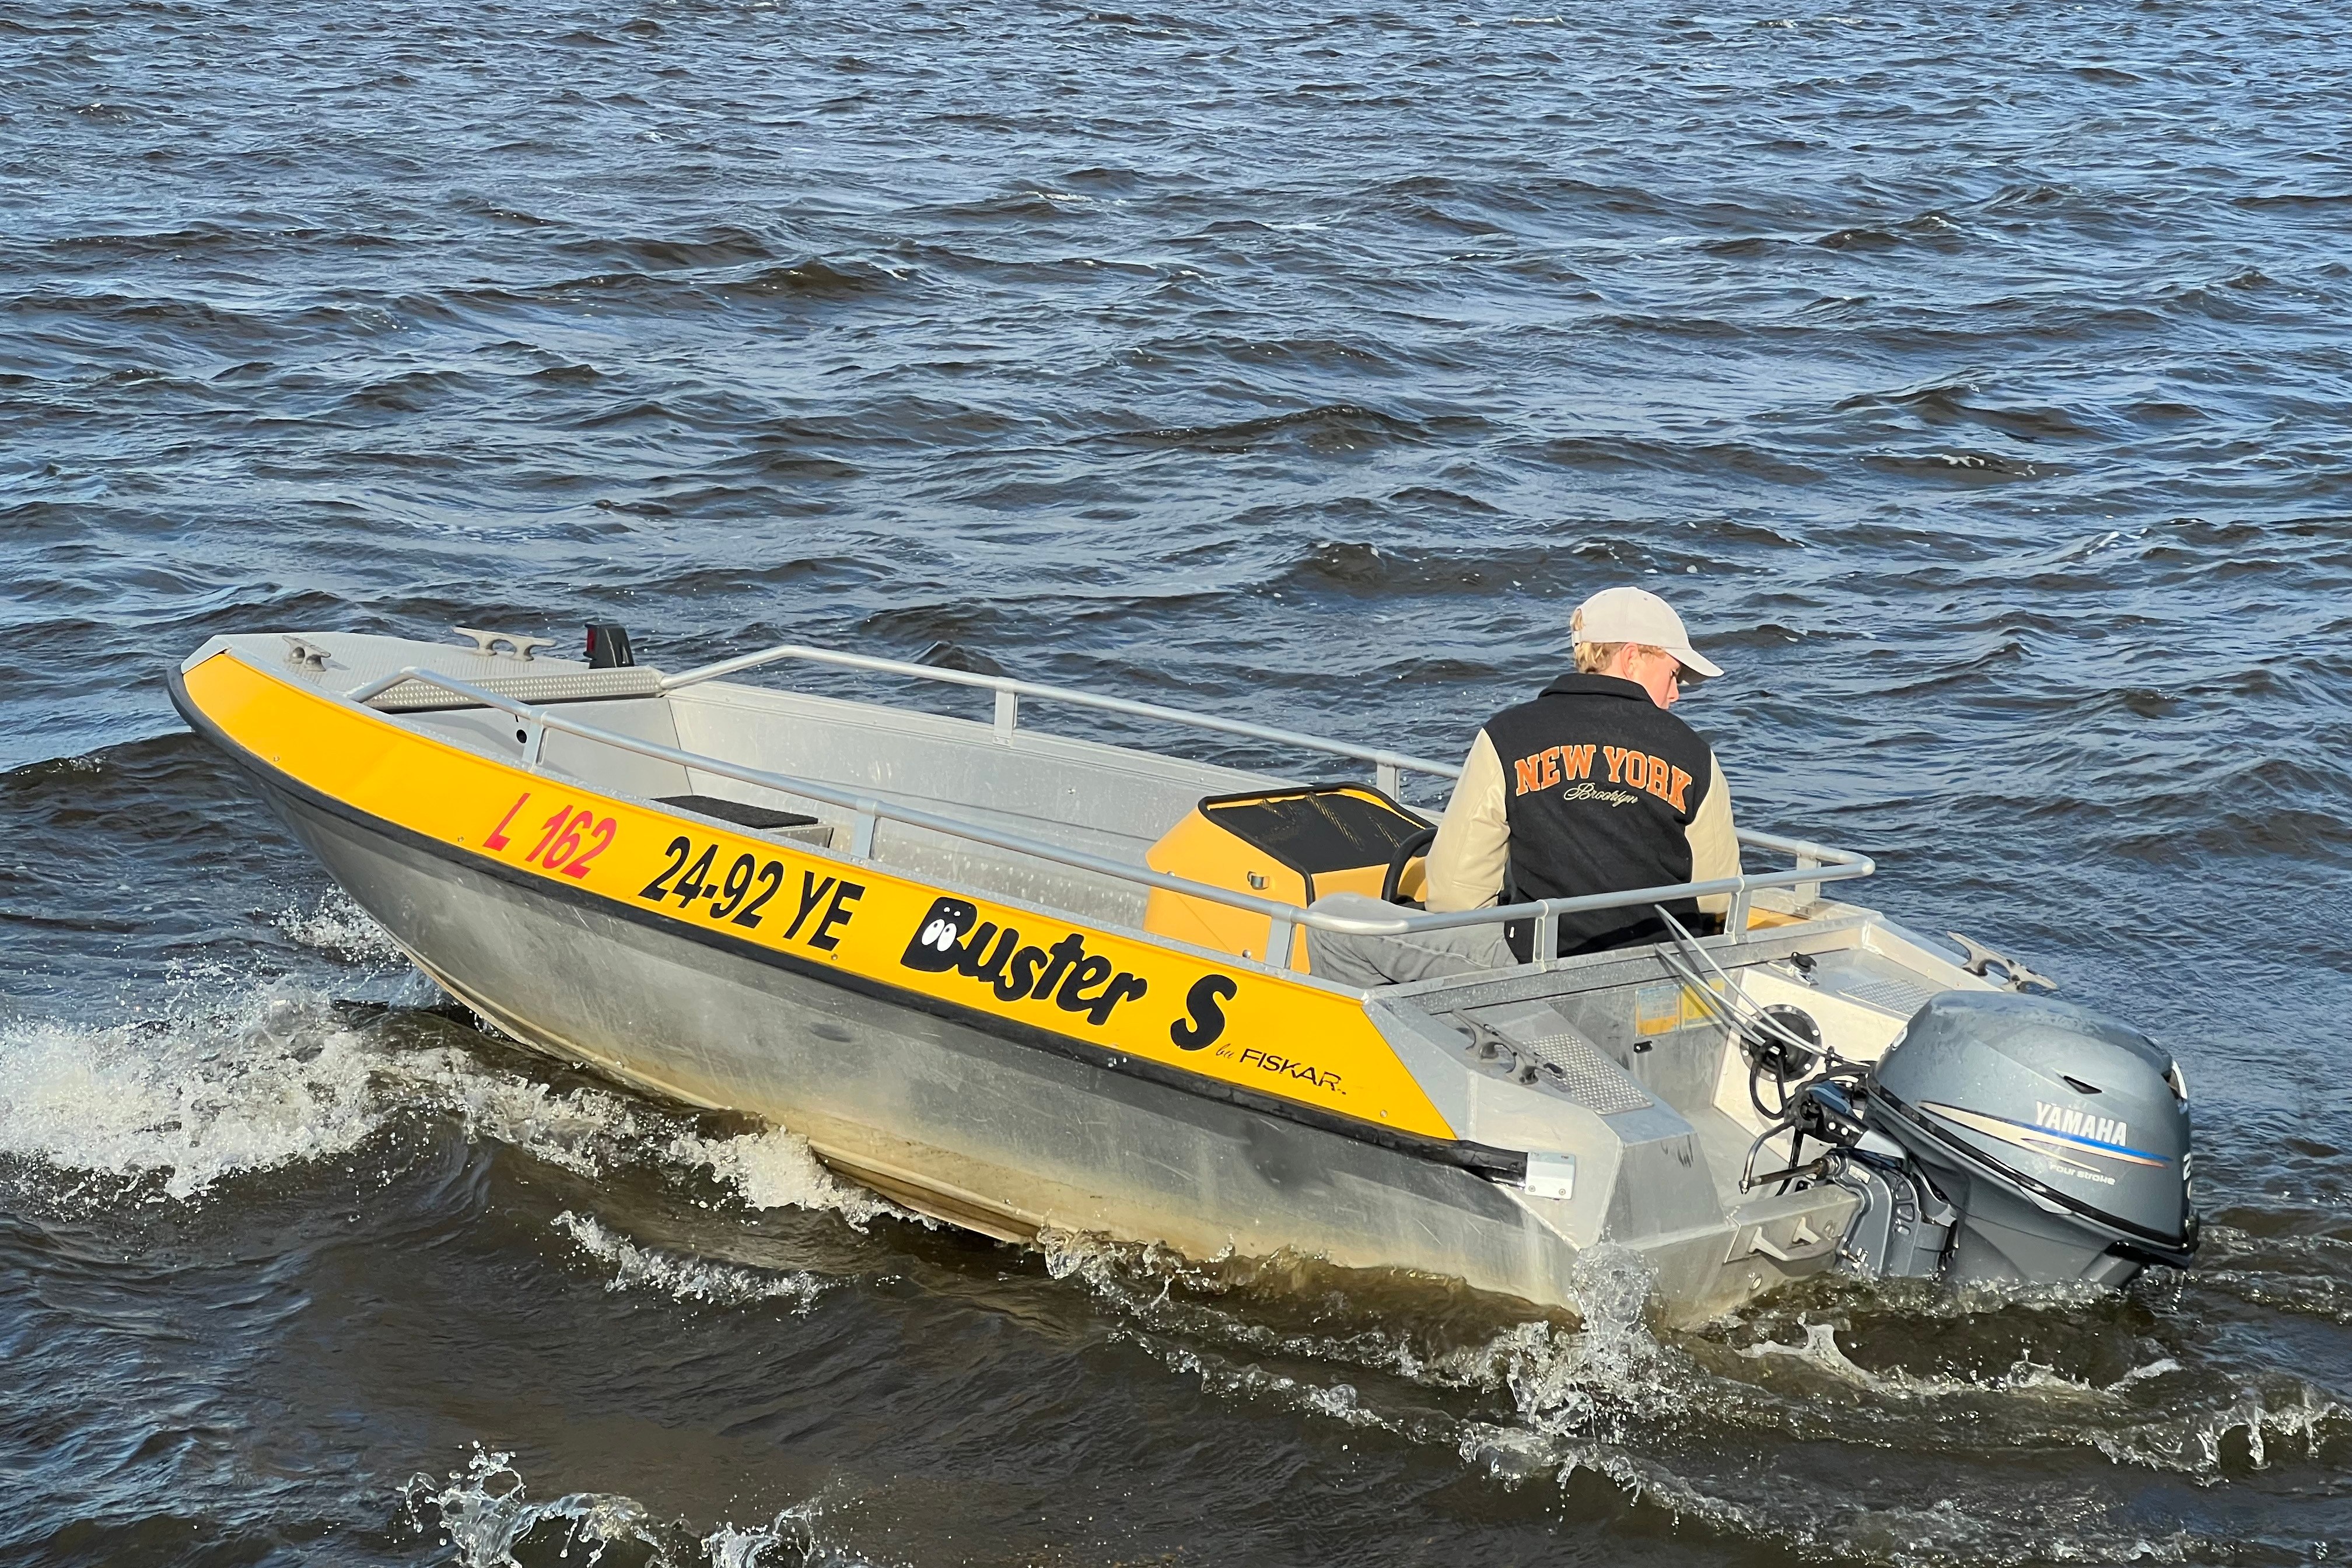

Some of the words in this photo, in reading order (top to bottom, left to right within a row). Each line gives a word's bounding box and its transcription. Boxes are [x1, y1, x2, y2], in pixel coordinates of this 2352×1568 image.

[1514, 744, 1597, 796] NEW
[1603, 745, 1693, 815] YORK
[1563, 782, 1639, 807] Brooklyn
[484, 793, 531, 852] L
[525, 805, 617, 879] 162
[638, 836, 784, 929] 24-92
[783, 870, 866, 951] YE
[900, 897, 1147, 1026] Buster
[1170, 974, 1237, 1051] S
[1239, 1048, 1347, 1096] FISKAR
[2036, 1100, 2128, 1147] YAMAHA
